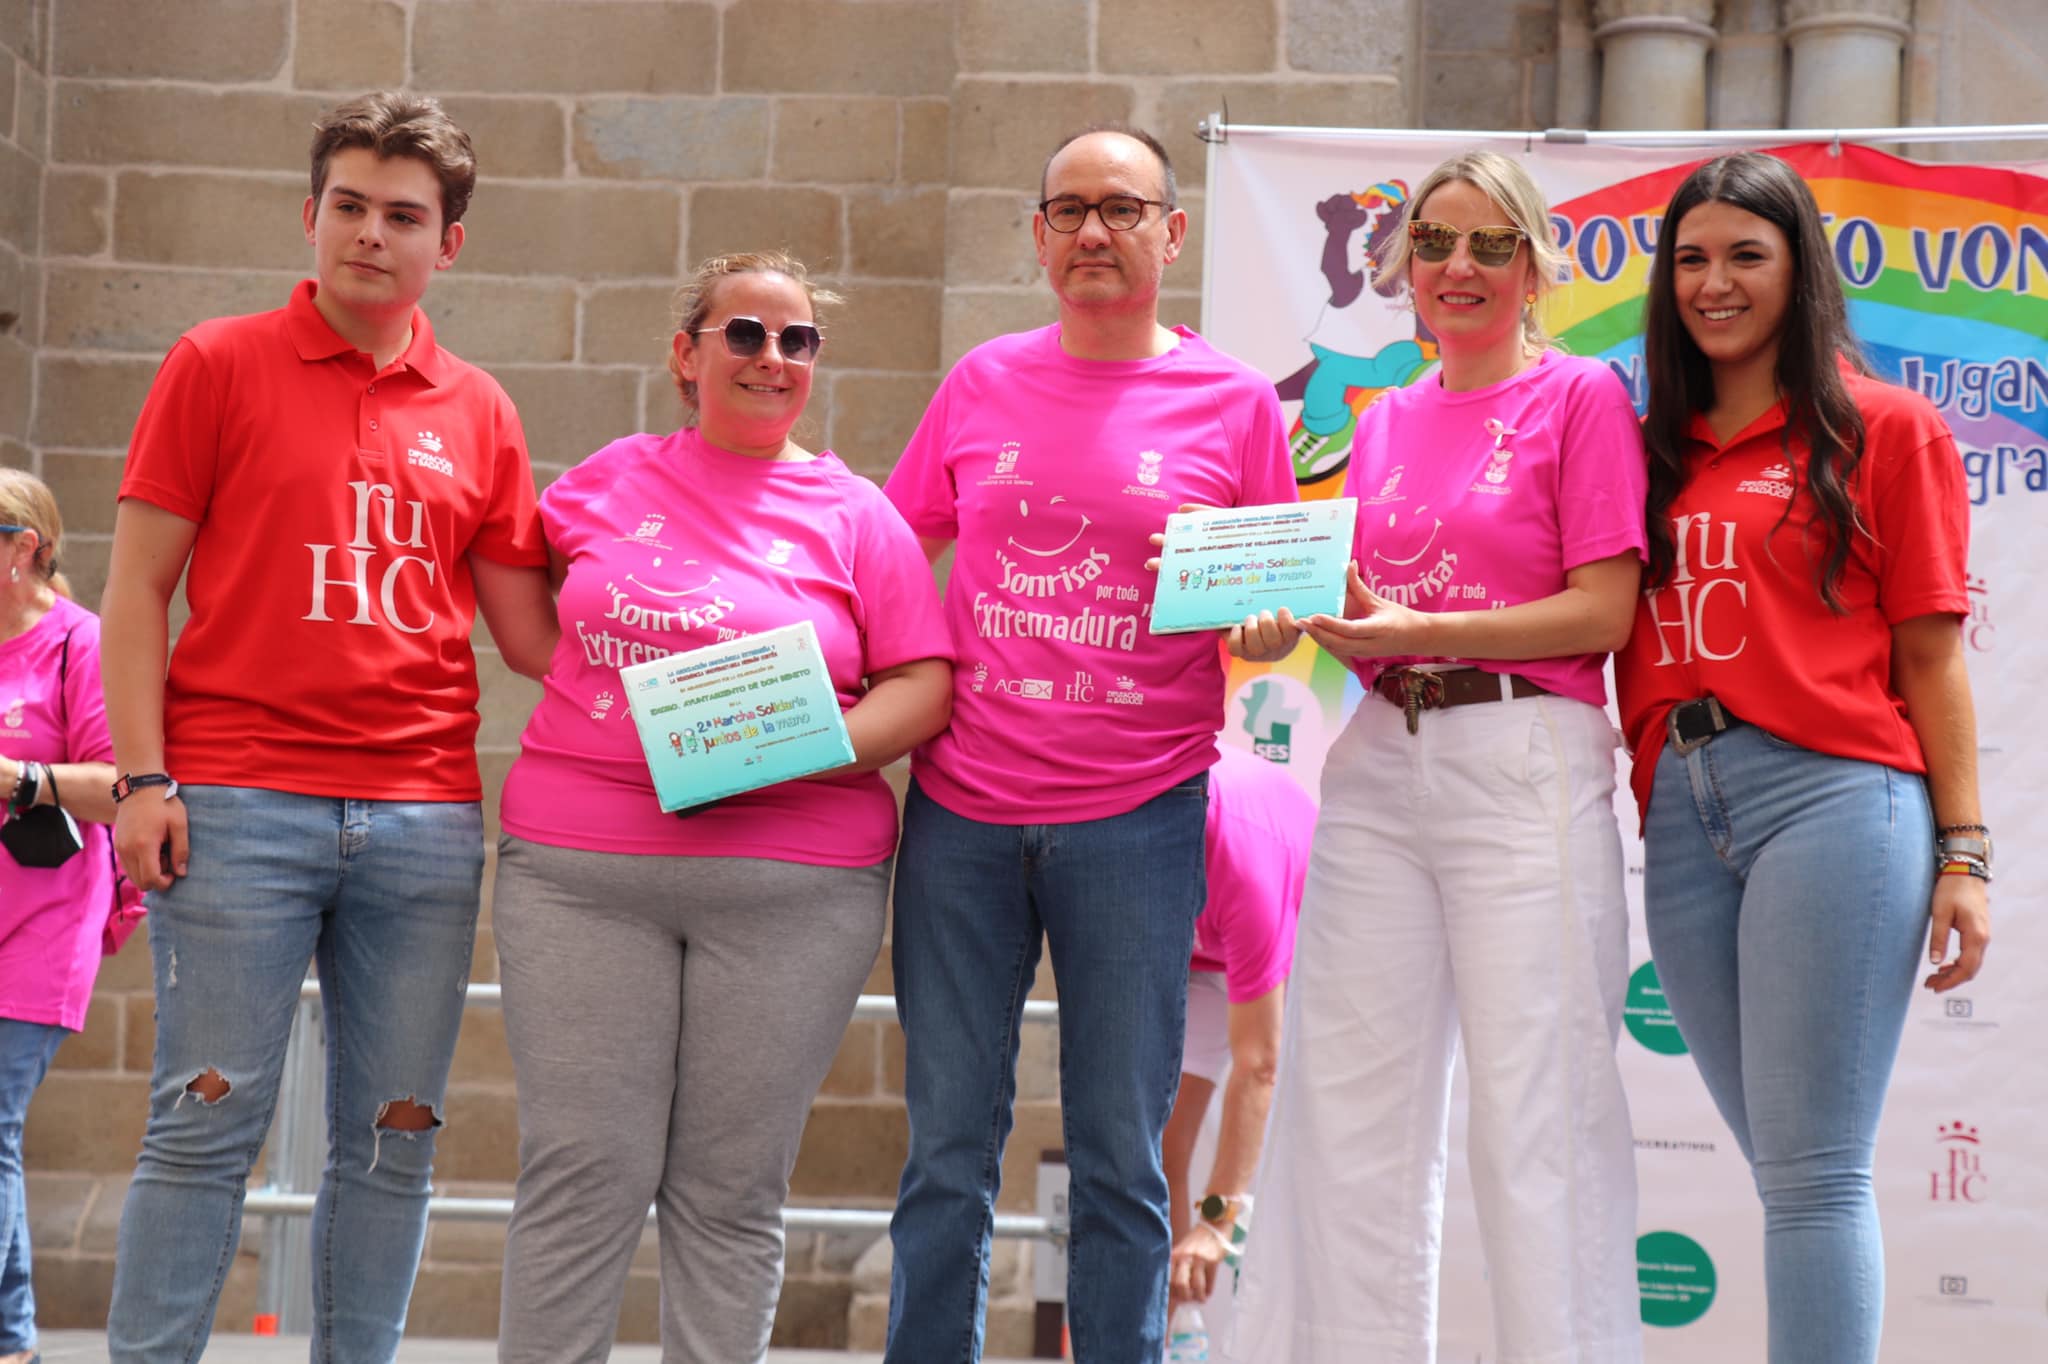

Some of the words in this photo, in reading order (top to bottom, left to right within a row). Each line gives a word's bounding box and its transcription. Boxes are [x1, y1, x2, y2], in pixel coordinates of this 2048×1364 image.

[347, 480, 427, 549] ru
[1672, 512, 1739, 583] ru
[1224, 560, 1264, 571] Marcha
[1266, 556, 1316, 569] Solidaria
[301, 543, 436, 634] HC
[1096, 585, 1112, 601] por
[1117, 584, 1139, 602] toda
[1462, 582, 1487, 599] toda
[1644, 577, 1747, 666] HC
[747, 681, 758, 690] DE
[760, 676, 778, 687] DON
[779, 668, 810, 681] BENITO
[712, 711, 756, 728] Marcha
[756, 696, 808, 717] Solidaria
[744, 725, 759, 739] de
[762, 720, 775, 734] la
[776, 713, 811, 730] mano
[1256, 743, 1289, 760] SES
